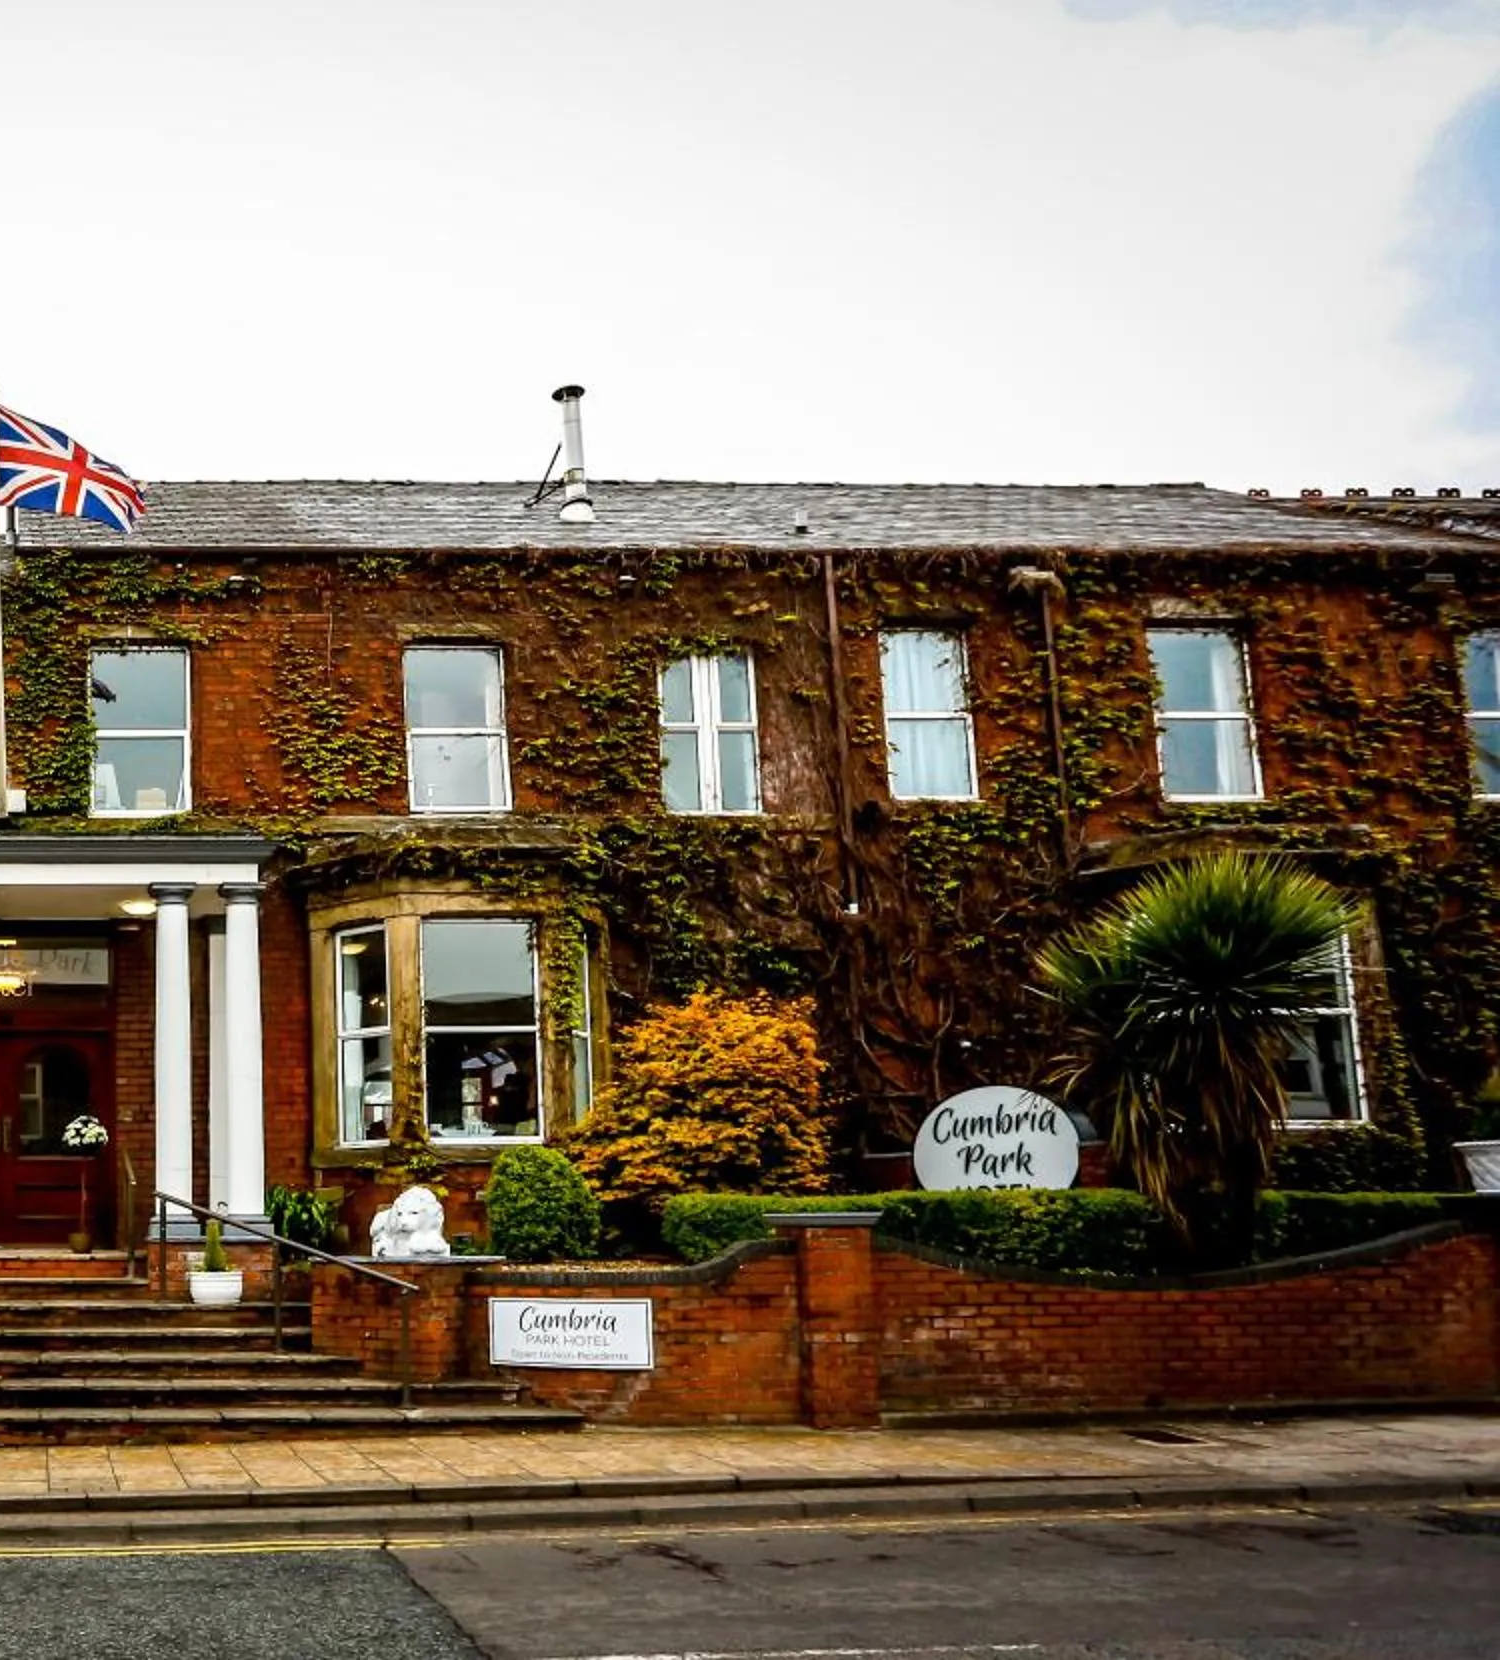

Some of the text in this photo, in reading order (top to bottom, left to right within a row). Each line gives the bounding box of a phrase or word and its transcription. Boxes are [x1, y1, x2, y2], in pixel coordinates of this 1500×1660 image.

[932, 1104, 1058, 1145] Cumbria
[956, 1141, 1035, 1179] Park
[518, 1305, 618, 1335] Cumbria
[525, 1333, 611, 1347] PARK HOTEL
